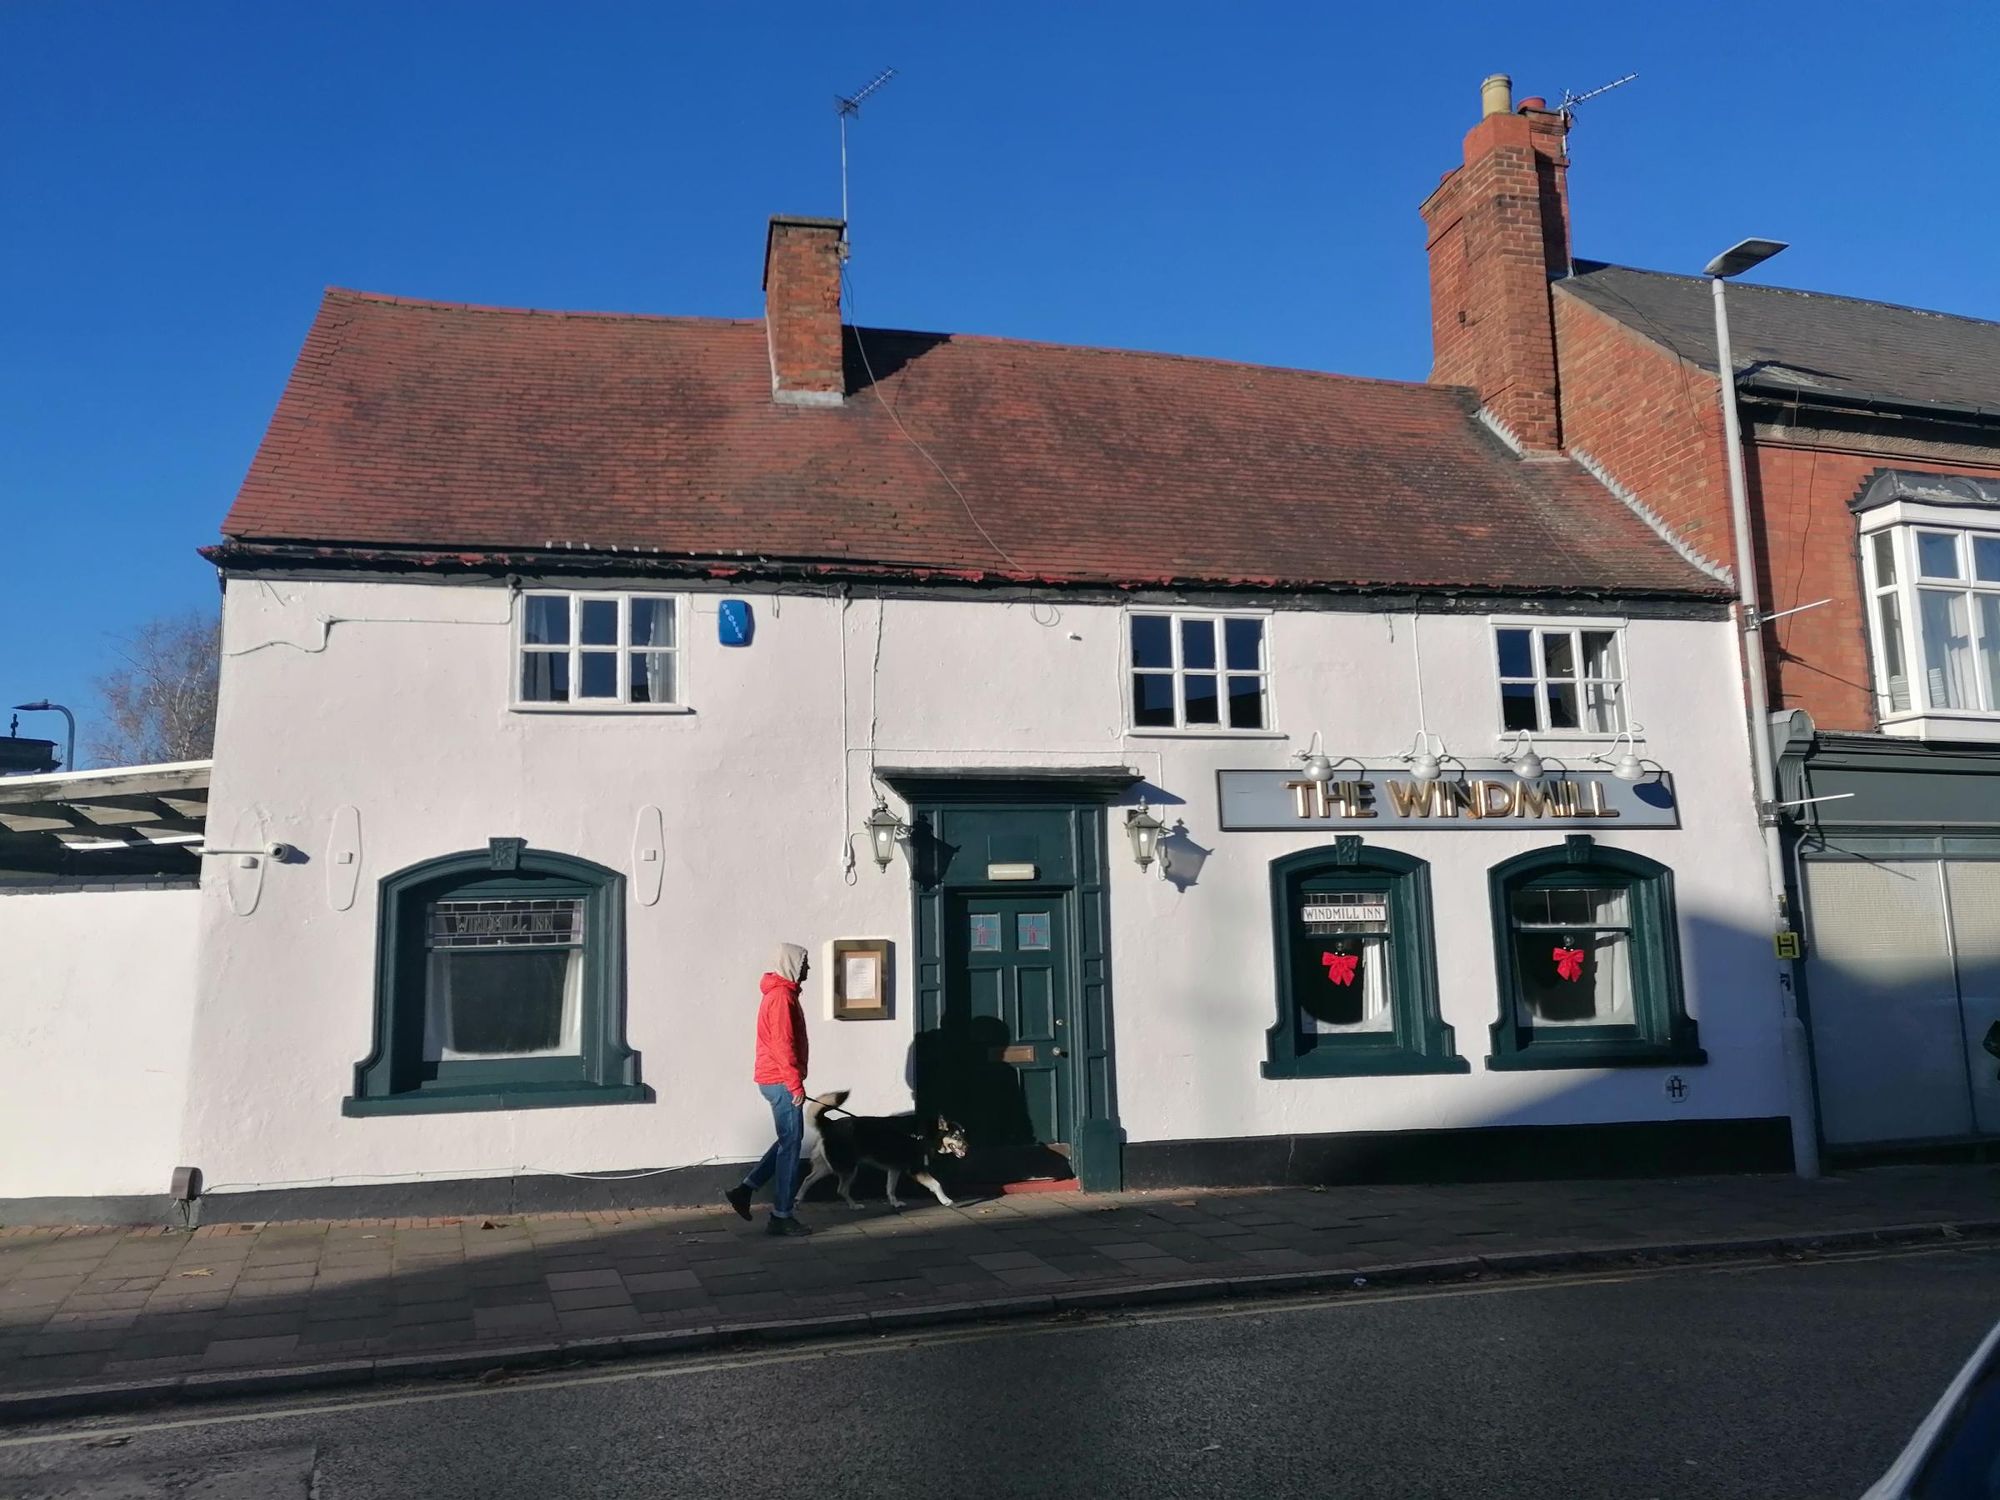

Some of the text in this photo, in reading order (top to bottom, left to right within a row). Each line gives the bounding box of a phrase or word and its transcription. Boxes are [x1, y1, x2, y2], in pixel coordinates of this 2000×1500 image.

[1285, 779, 1620, 820] THE WINDMILL
[1304, 906, 1383, 921] WINDMILL INN
[455, 914, 554, 933] WINDMILL INN
[1777, 936, 1796, 956] H
